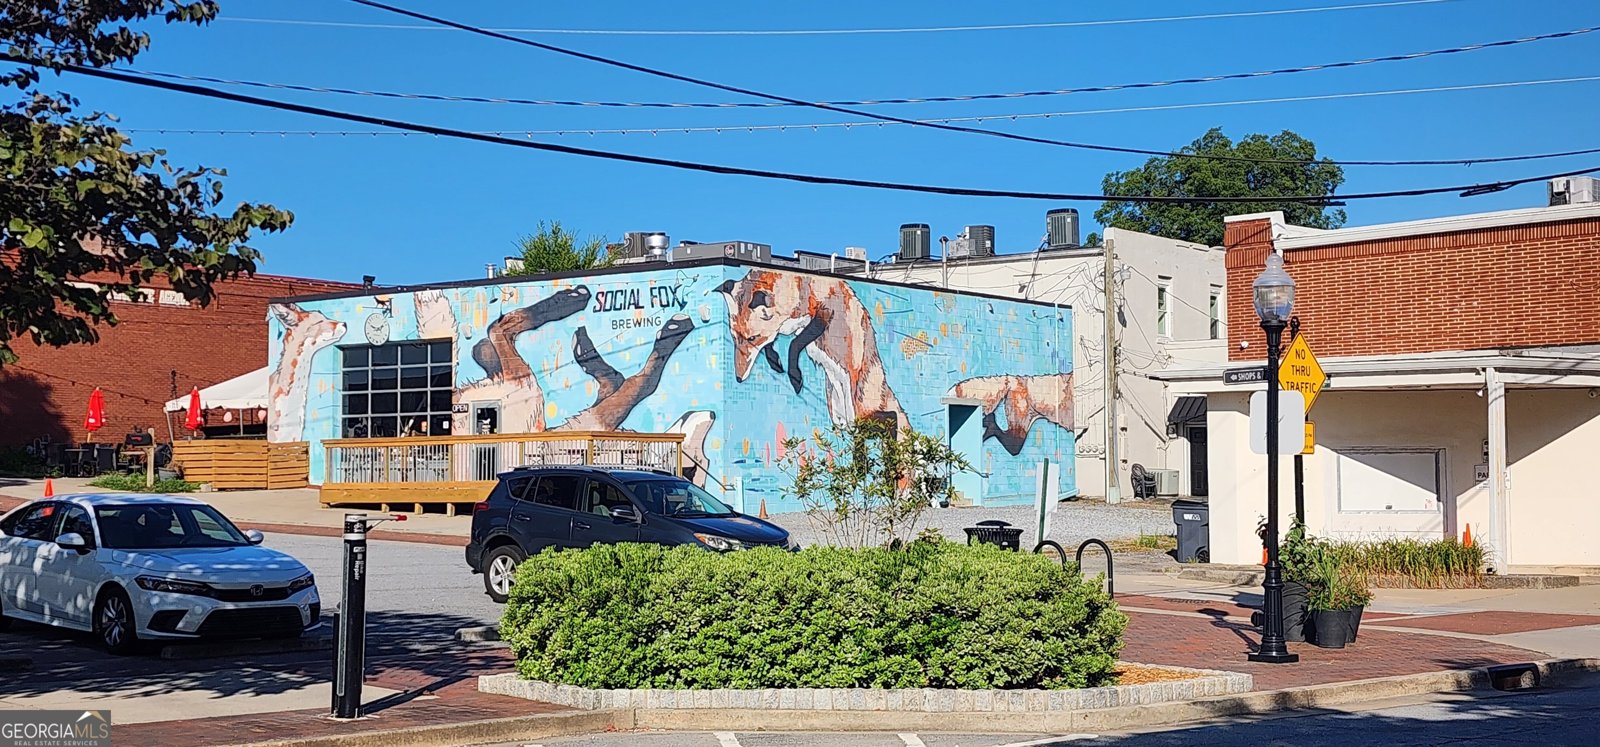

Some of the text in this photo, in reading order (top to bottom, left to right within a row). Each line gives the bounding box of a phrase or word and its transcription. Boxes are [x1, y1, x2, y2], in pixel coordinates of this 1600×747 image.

[592, 284, 683, 313] SOCIAL FOX
[611, 316, 661, 330] BREWING
[1295, 348, 1306, 360] NO
[1238, 372, 1256, 381] SHOPS
[1291, 364, 1311, 377] THRU
[1286, 381, 1317, 394] TRAFFIC
[453, 404, 468, 412] OPEN
